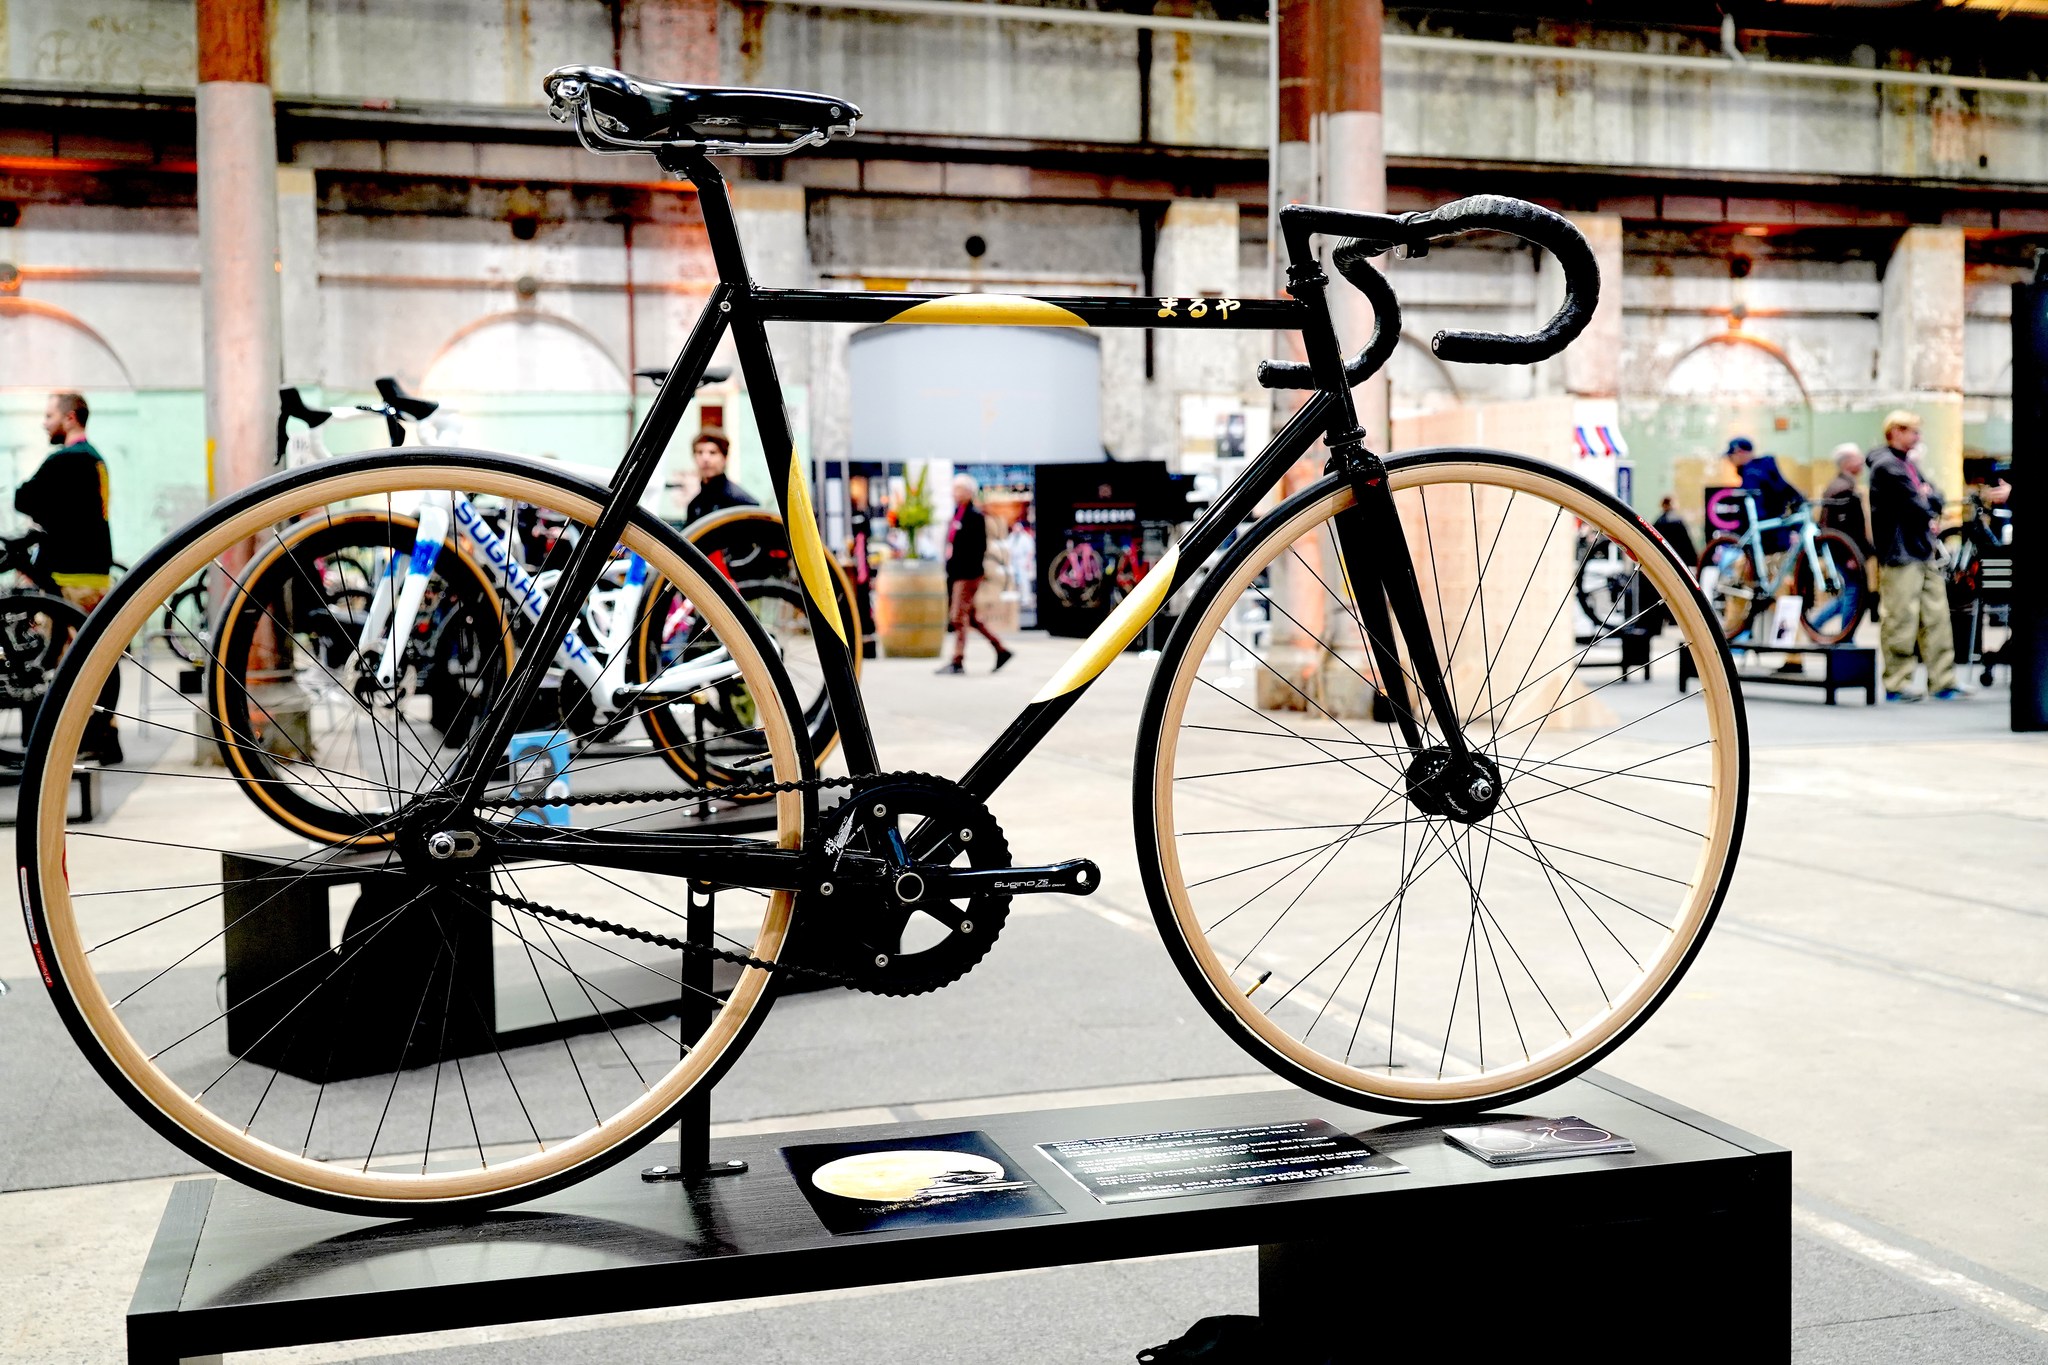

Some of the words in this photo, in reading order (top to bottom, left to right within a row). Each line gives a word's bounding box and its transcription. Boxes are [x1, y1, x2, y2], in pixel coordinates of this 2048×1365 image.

[1158, 298, 1240, 320] まるや
[455, 501, 587, 664] SUGARLAF
[994, 880, 1036, 890] Sugino
